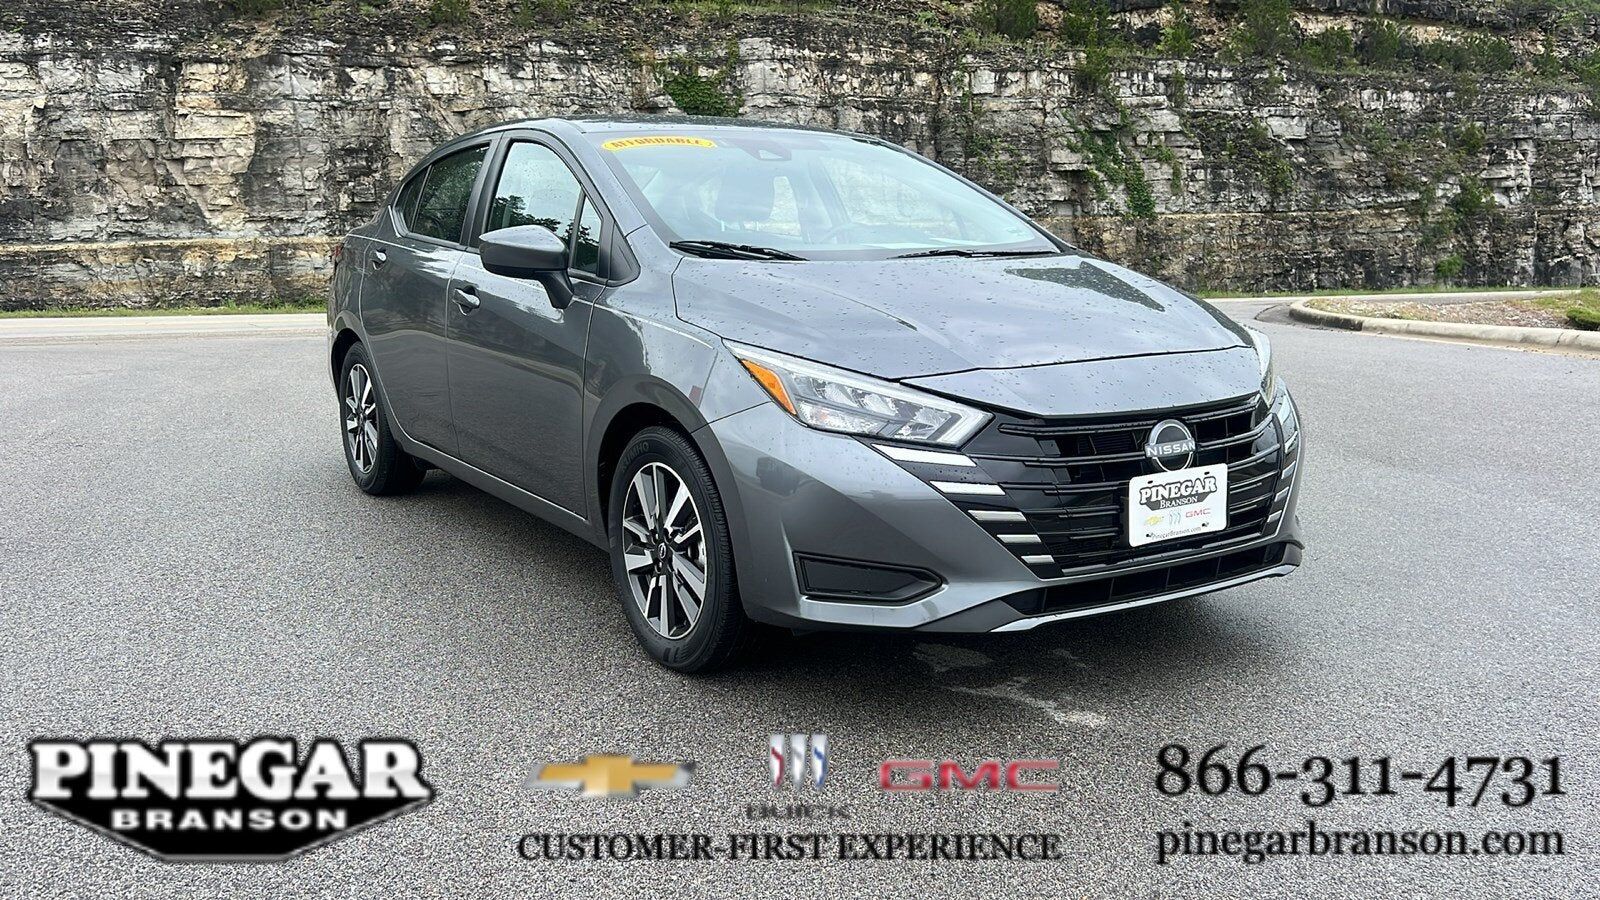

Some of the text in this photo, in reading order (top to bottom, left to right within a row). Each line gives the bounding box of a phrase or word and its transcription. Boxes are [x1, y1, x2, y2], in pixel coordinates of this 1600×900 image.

[611, 137, 698, 148] AFFORDABLE
[1147, 440, 1196, 456] NISSAN
[1140, 476, 1217, 504] PINEGAR
[1159, 496, 1198, 509] BRANSON
[1185, 508, 1211, 518] GMC
